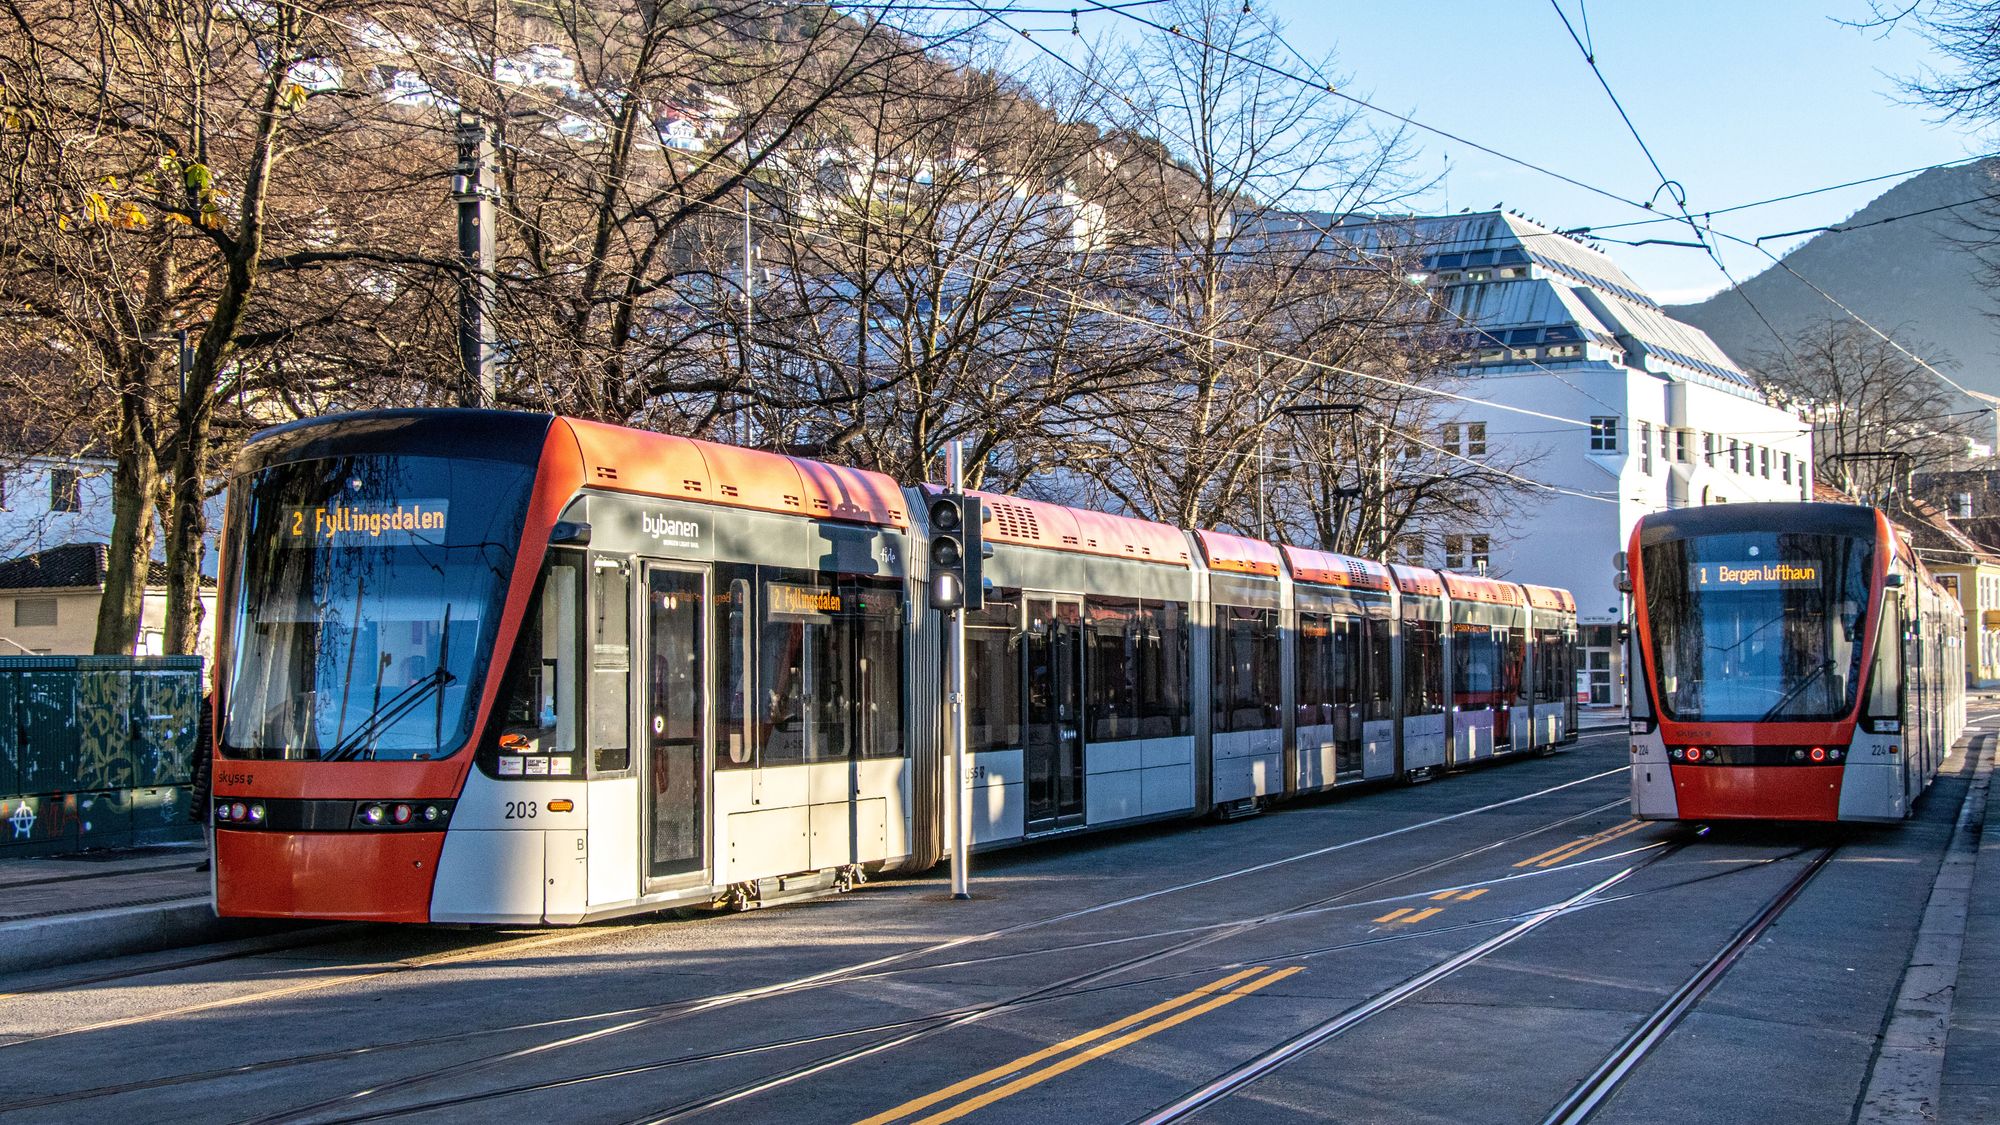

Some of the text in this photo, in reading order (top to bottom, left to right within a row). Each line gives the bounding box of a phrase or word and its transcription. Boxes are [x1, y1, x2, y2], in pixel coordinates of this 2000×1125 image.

[293, 505, 444, 538] 2 Fyllingsdalen
[642, 511, 699, 538] bybanen
[880, 546, 896, 563] tide
[1700, 568, 1708, 584] 1
[1719, 566, 1762, 585] Bergen
[774, 586, 841, 613] 2 Fyllingsdalen
[1639, 745, 1649, 756] 224
[1871, 744, 1887, 756] 224
[218, 771, 245, 786] skyss
[505, 802, 537, 818] 203
[577, 839, 584, 850] B
